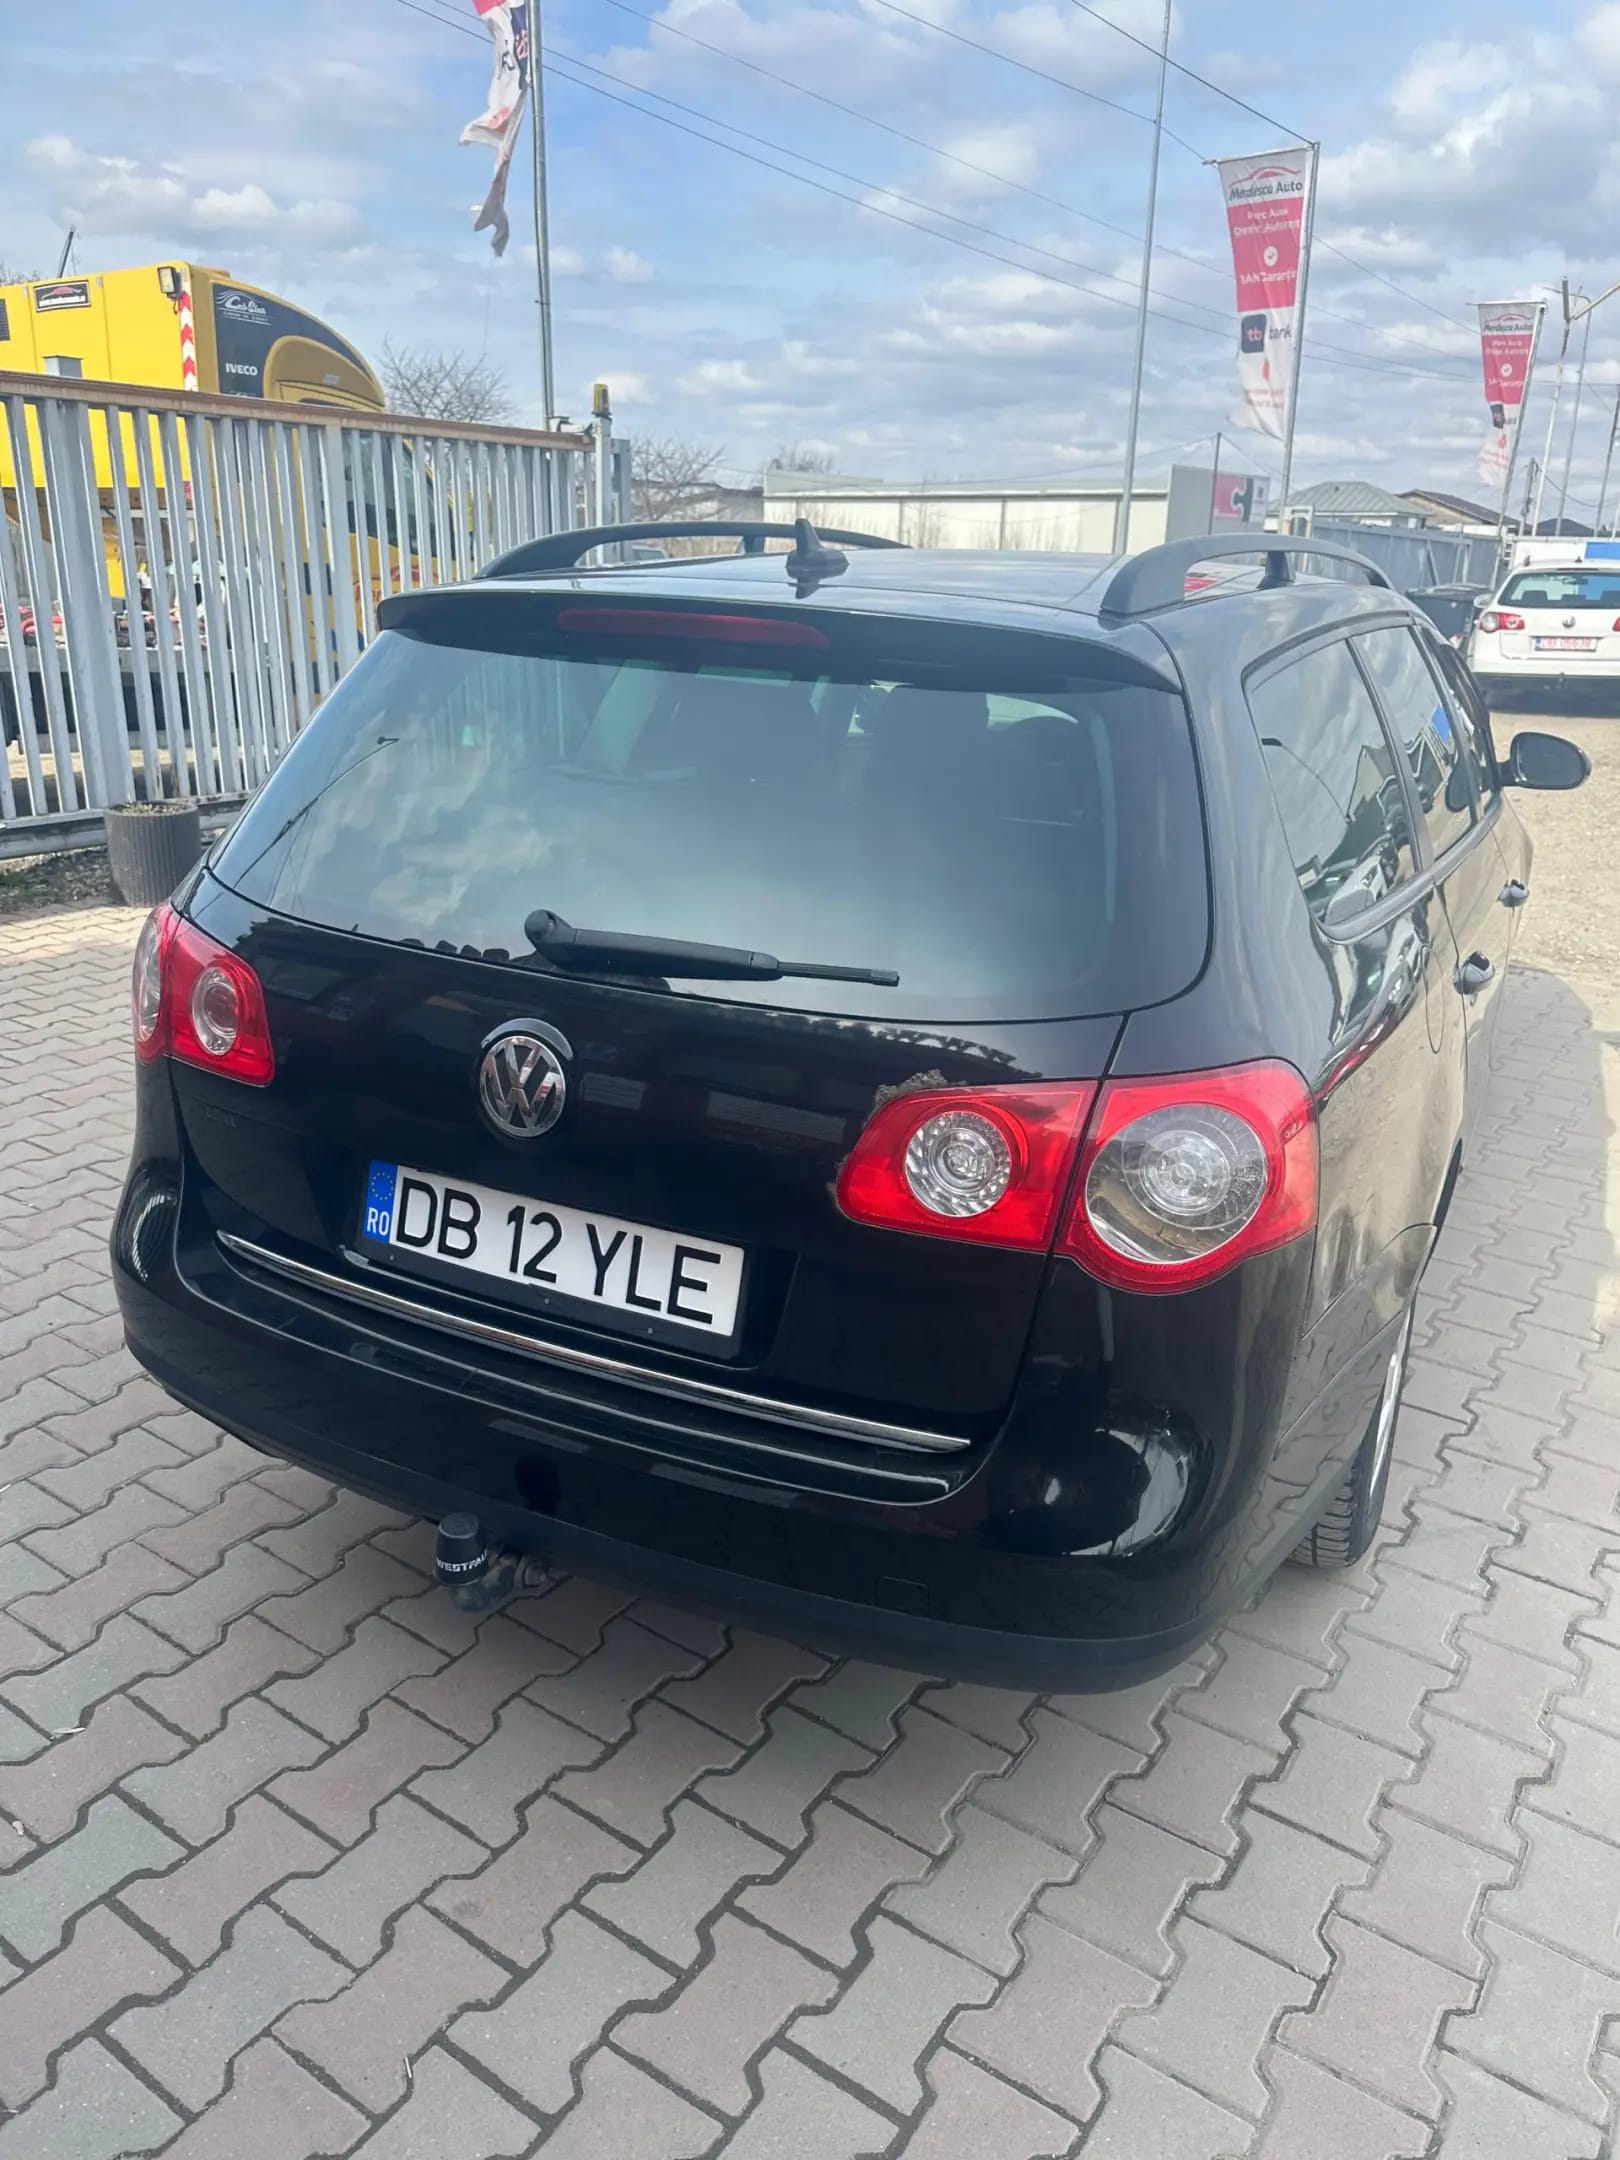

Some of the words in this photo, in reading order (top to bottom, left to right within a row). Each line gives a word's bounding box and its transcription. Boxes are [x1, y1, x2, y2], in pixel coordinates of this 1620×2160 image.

[1276, 180, 1303, 193] Auto
[225, 362, 258, 376] IVECO
[367, 1207, 390, 1237] RO
[396, 1177, 481, 1259] DB
[507, 1205, 563, 1284] 12
[586, 1223, 721, 1325] YLE
